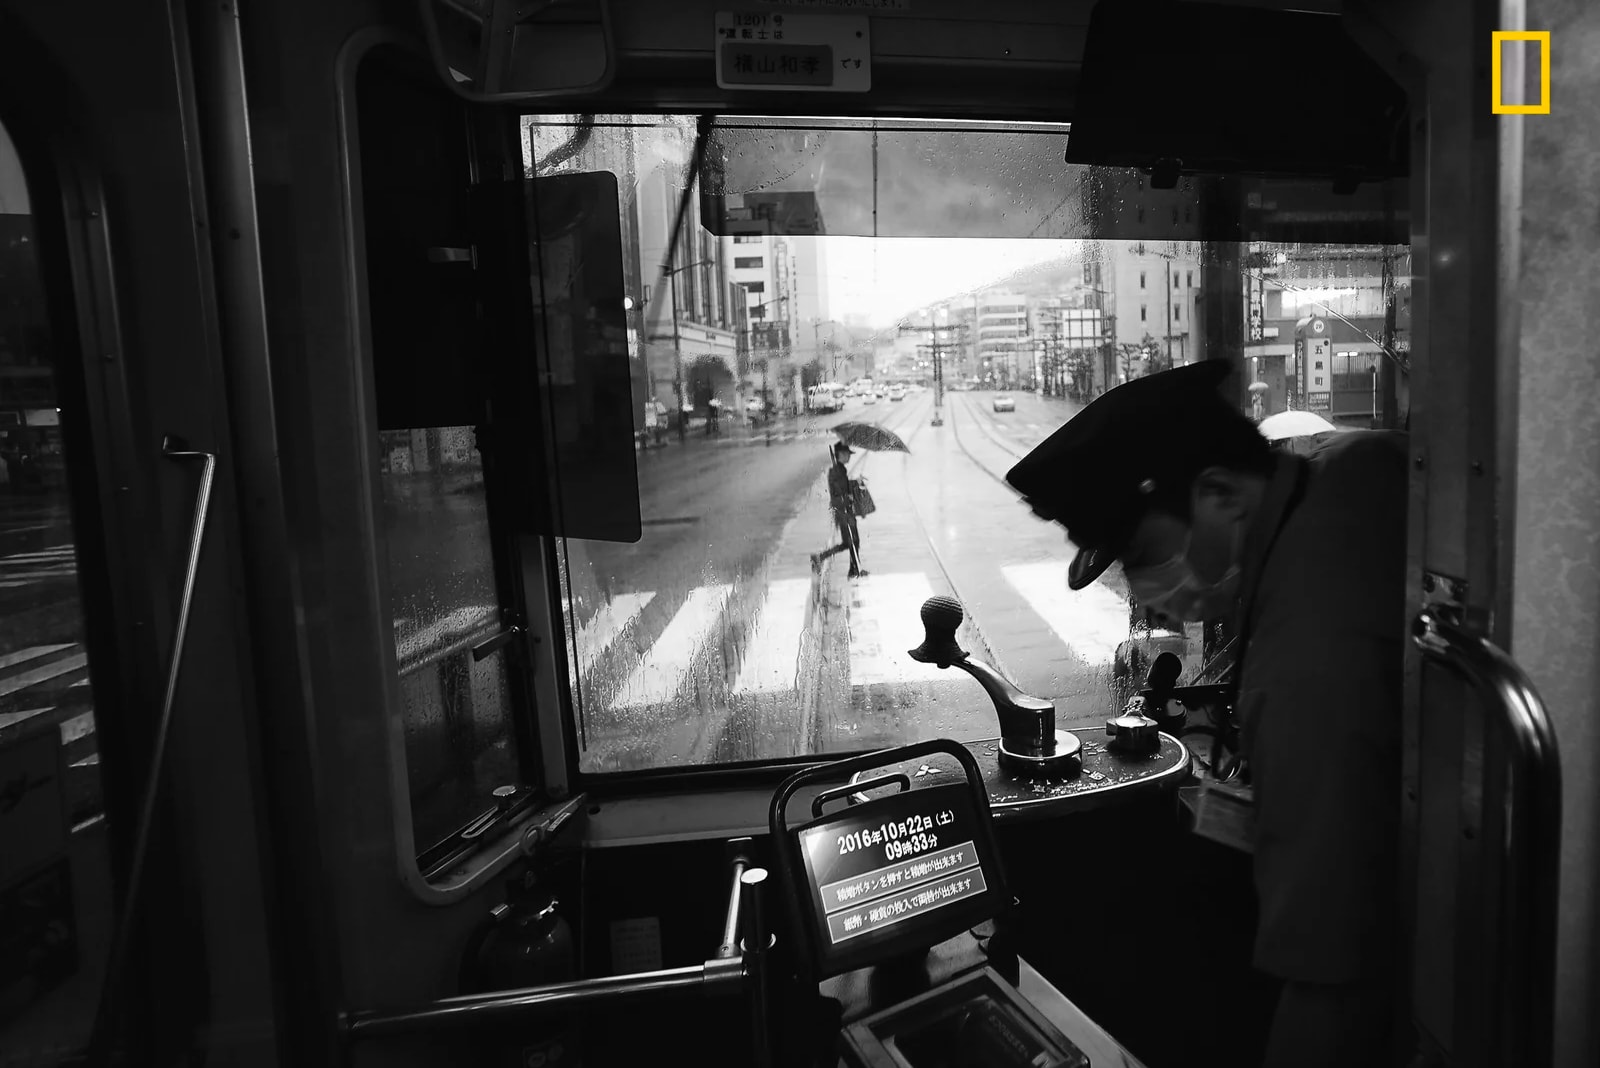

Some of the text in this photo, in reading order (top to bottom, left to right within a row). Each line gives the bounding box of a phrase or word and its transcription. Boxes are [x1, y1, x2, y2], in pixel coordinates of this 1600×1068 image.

[725, 28, 784, 40] 運転士は
[840, 58, 863, 70] です
[1314, 345, 1324, 386] 五島町
[885, 833, 938, 861] 09時33分
